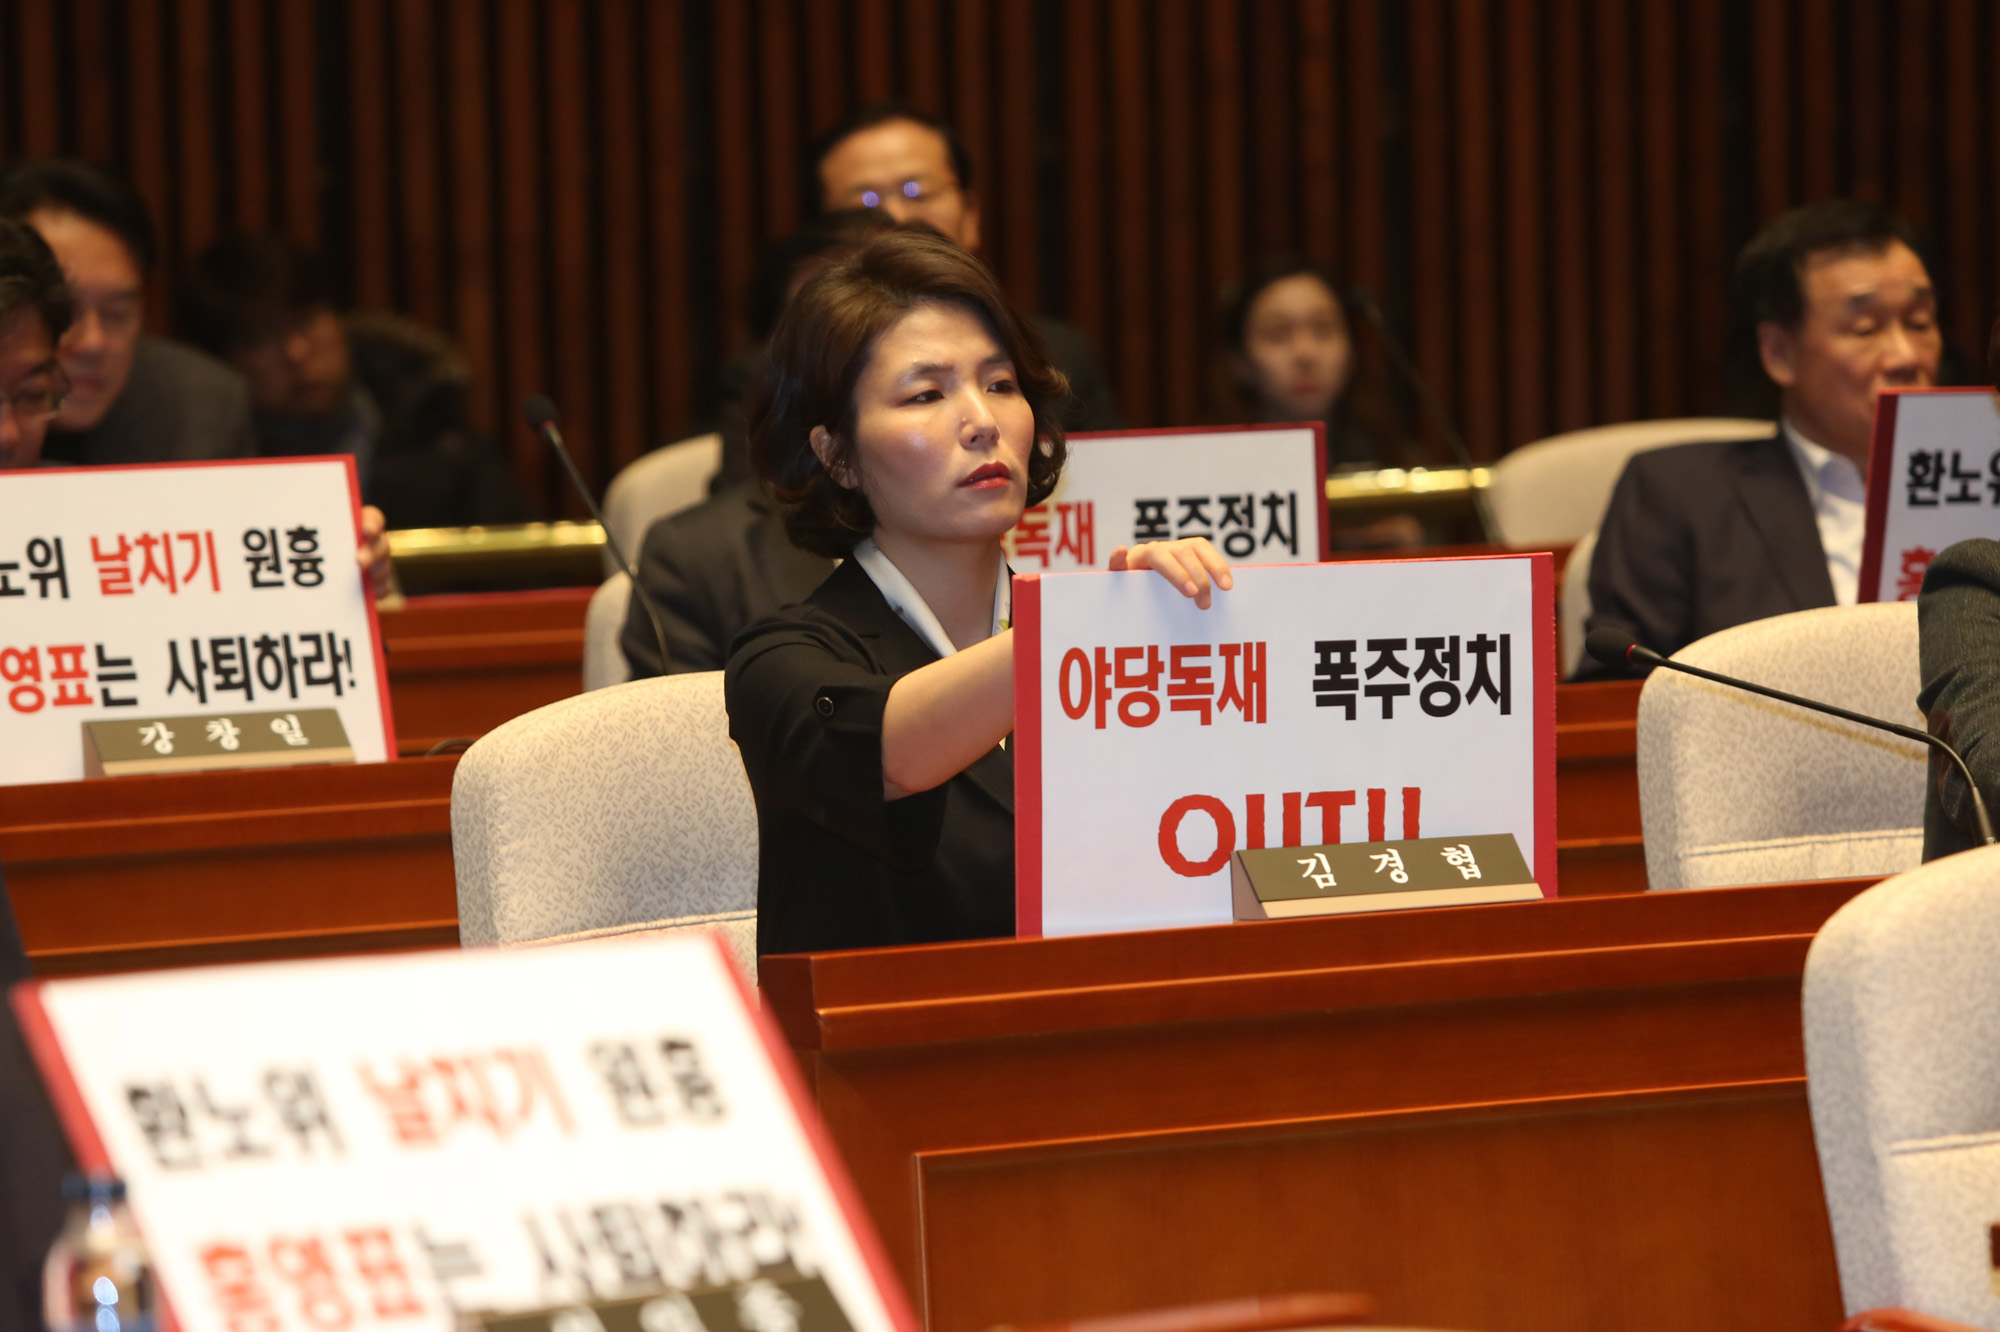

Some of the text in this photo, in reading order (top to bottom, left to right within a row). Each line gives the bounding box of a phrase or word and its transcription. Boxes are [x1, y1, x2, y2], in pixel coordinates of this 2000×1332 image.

[90, 529, 221, 597] 날치기
[243, 526, 325, 589] 원흉
[1000, 500, 1095, 568] 독재
[0, 631, 356, 714] 영표는 사퇴하라!
[1059, 633, 1511, 729] 야당독재 폭주정치
[358, 1043, 578, 1148] 날치기
